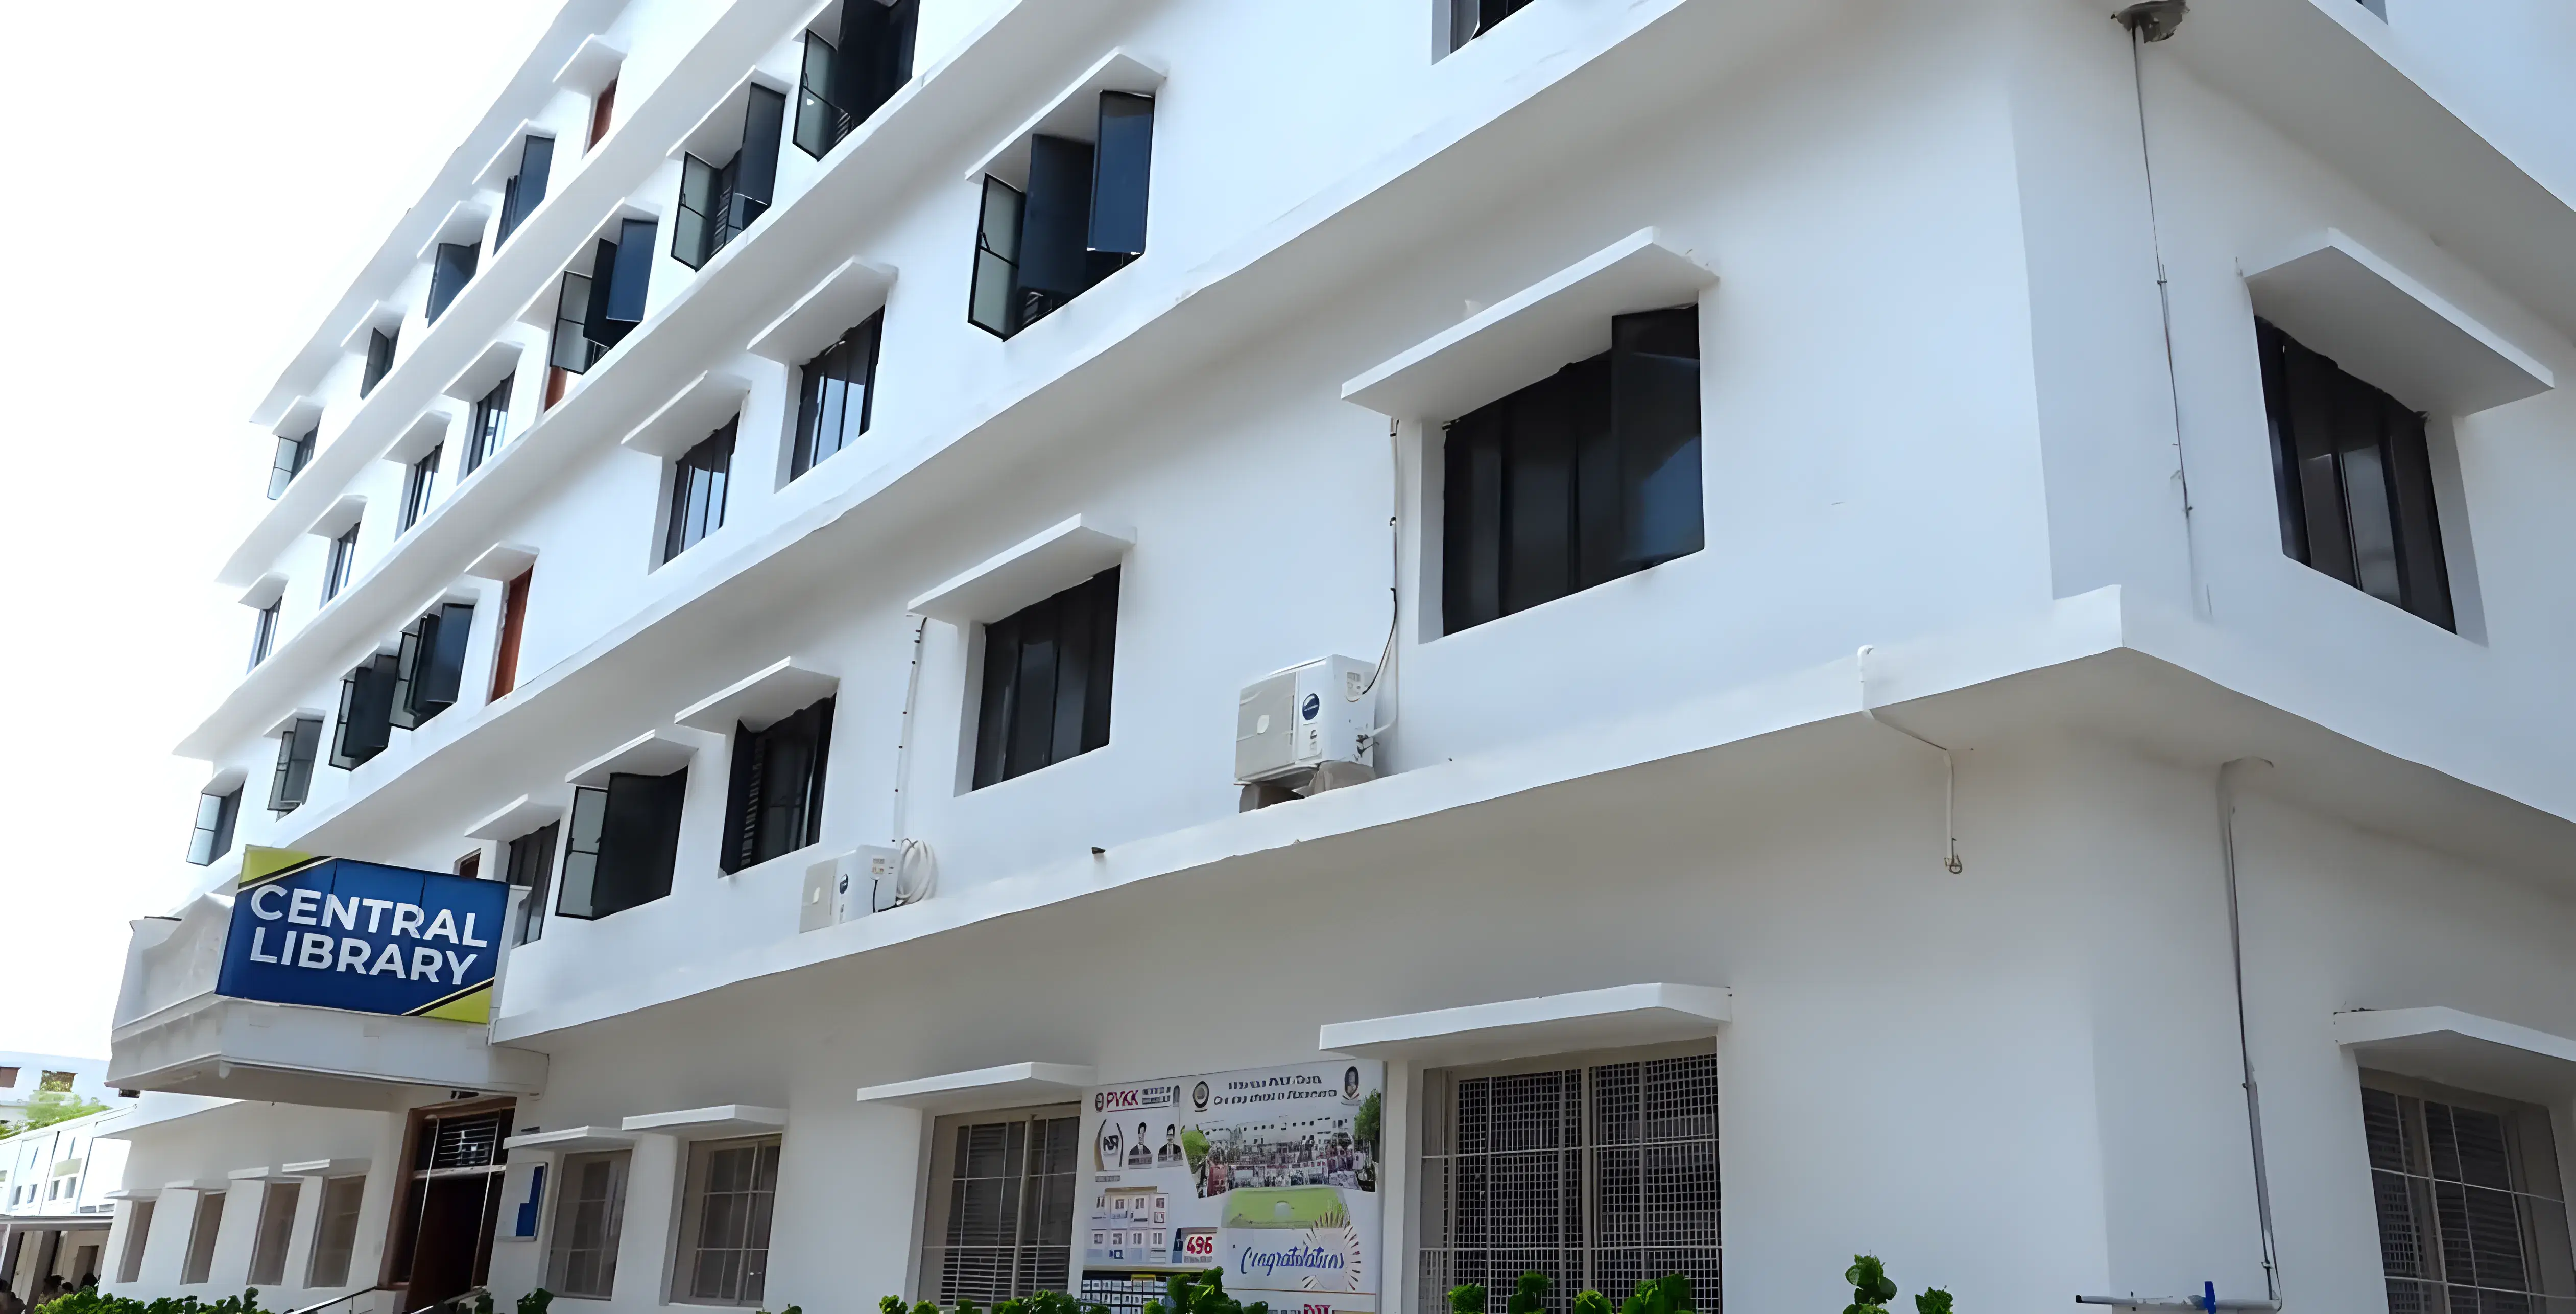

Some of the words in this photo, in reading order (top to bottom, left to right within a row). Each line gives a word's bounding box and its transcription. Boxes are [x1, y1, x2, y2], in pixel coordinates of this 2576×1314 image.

[251, 884, 487, 948] CENTRAL
[250, 926, 478, 986] LIBRARY
[1186, 1236, 1213, 1254] 496
